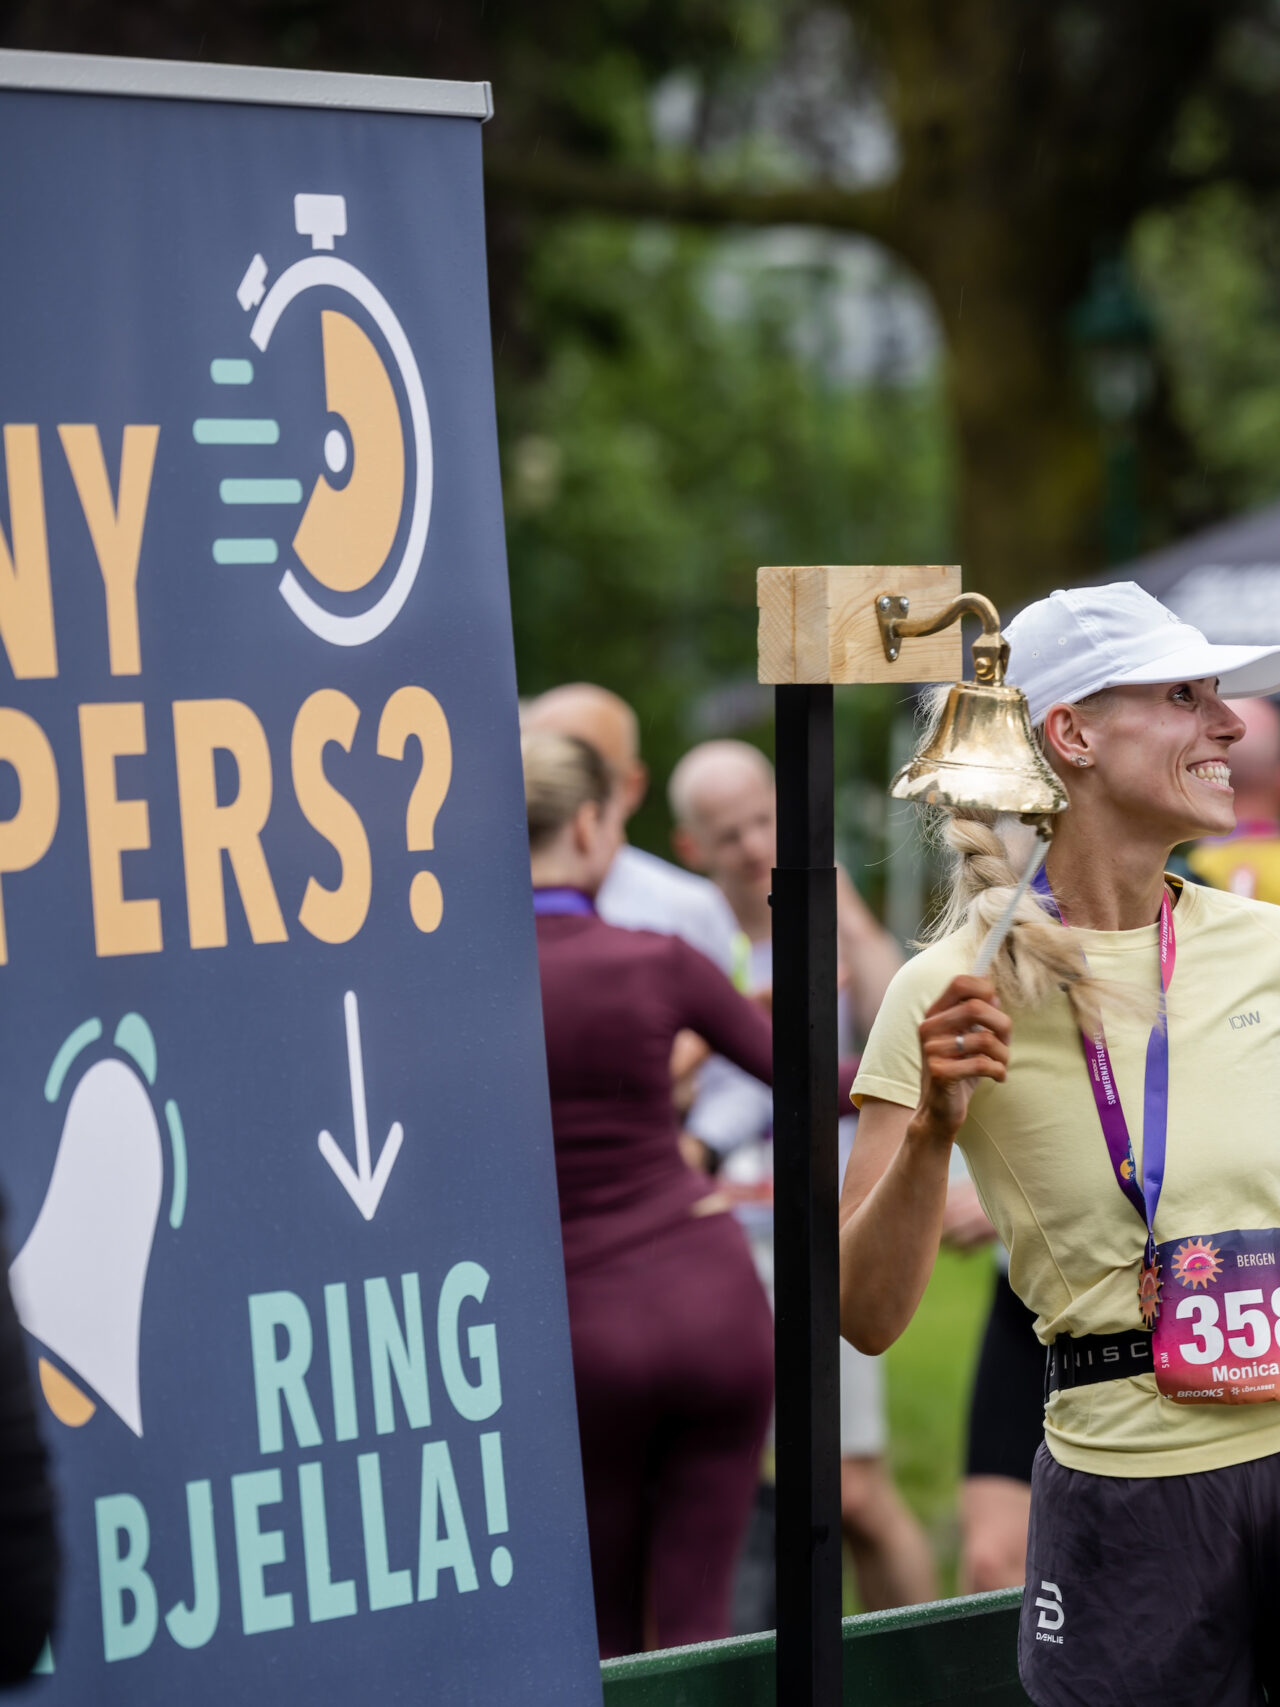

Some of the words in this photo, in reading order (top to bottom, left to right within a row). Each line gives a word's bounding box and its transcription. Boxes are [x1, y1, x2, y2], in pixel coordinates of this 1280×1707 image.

[0, 424, 161, 679] NY
[0, 685, 452, 965] PERS?
[248, 1260, 502, 1455] RING
[1236, 1253, 1276, 1268] BERGEN
[1176, 1388, 1225, 1398] BROOKS
[1212, 1361, 1280, 1382] Monica
[95, 1431, 514, 1662] BJELLA!
